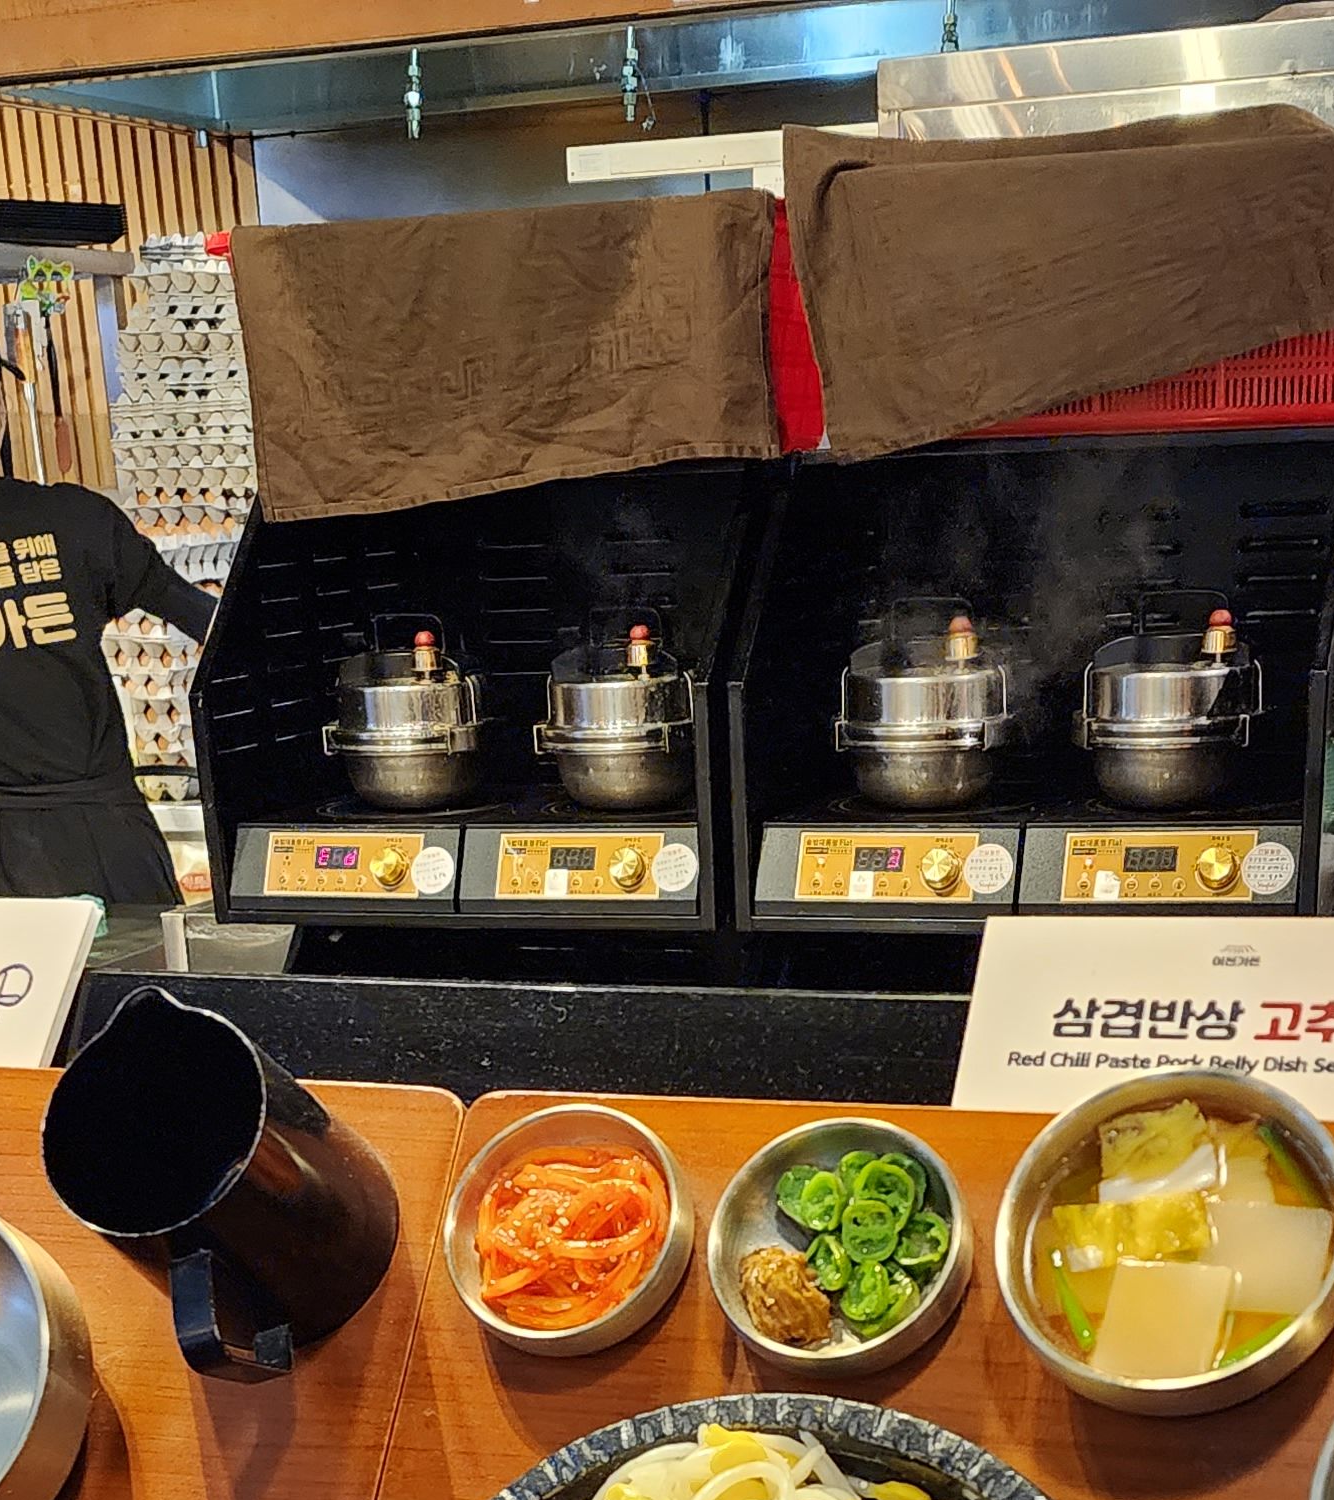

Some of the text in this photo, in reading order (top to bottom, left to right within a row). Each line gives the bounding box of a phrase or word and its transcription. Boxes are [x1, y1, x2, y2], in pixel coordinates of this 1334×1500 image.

[12, 533, 58, 560] 위해
[18, 557, 62, 584] 담은
[1053, 997, 1245, 1040] 삼겹반상
[1007, 1051, 1046, 1067] Red
[1050, 1051, 1090, 1068] Chili
[1095, 1053, 1151, 1069] Paste
[1209, 1055, 1259, 1075] Belly
[1263, 1056, 1308, 1073] Dish
